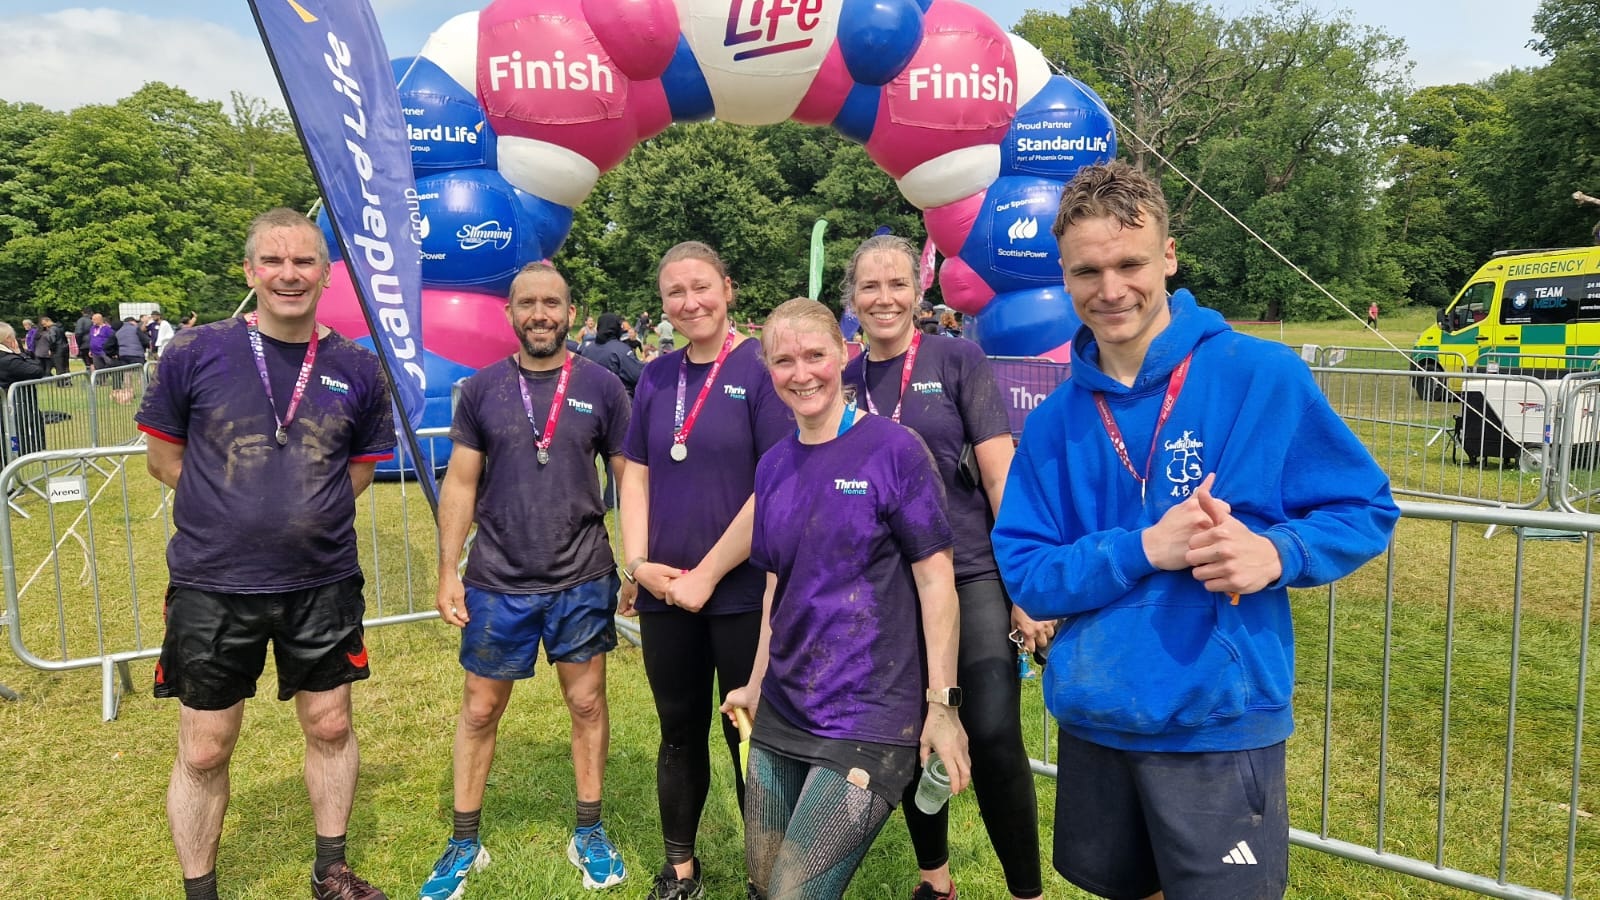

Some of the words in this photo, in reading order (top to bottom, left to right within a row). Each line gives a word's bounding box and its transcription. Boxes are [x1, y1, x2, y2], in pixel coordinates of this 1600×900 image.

[724, 0, 822, 46] Life
[489, 50, 613, 94] Finish
[323, 31, 366, 139] Life
[909, 63, 1014, 104] Finish
[402, 108, 425, 116] rtner
[1016, 122, 1041, 131] Proud
[1042, 121, 1073, 130] Partner
[445, 127, 477, 144] Life
[1017, 136, 1085, 152] Standard
[1086, 137, 1108, 153] Life
[996, 204, 1010, 212] Our
[456, 221, 513, 250] Slimming
[997, 248, 1049, 259] ScottishPower
[1507, 259, 1585, 277] EMERGENCY
[1535, 286, 1564, 298] TEAM
[1533, 297, 1568, 309] MEDIC
[320, 375, 349, 390] Thrive
[912, 381, 942, 392] Thrive
[723, 384, 746, 395] Thriv
[567, 398, 593, 410] Thrive
[834, 478, 869, 490] Thrive
[51, 489, 80, 497] Arena
